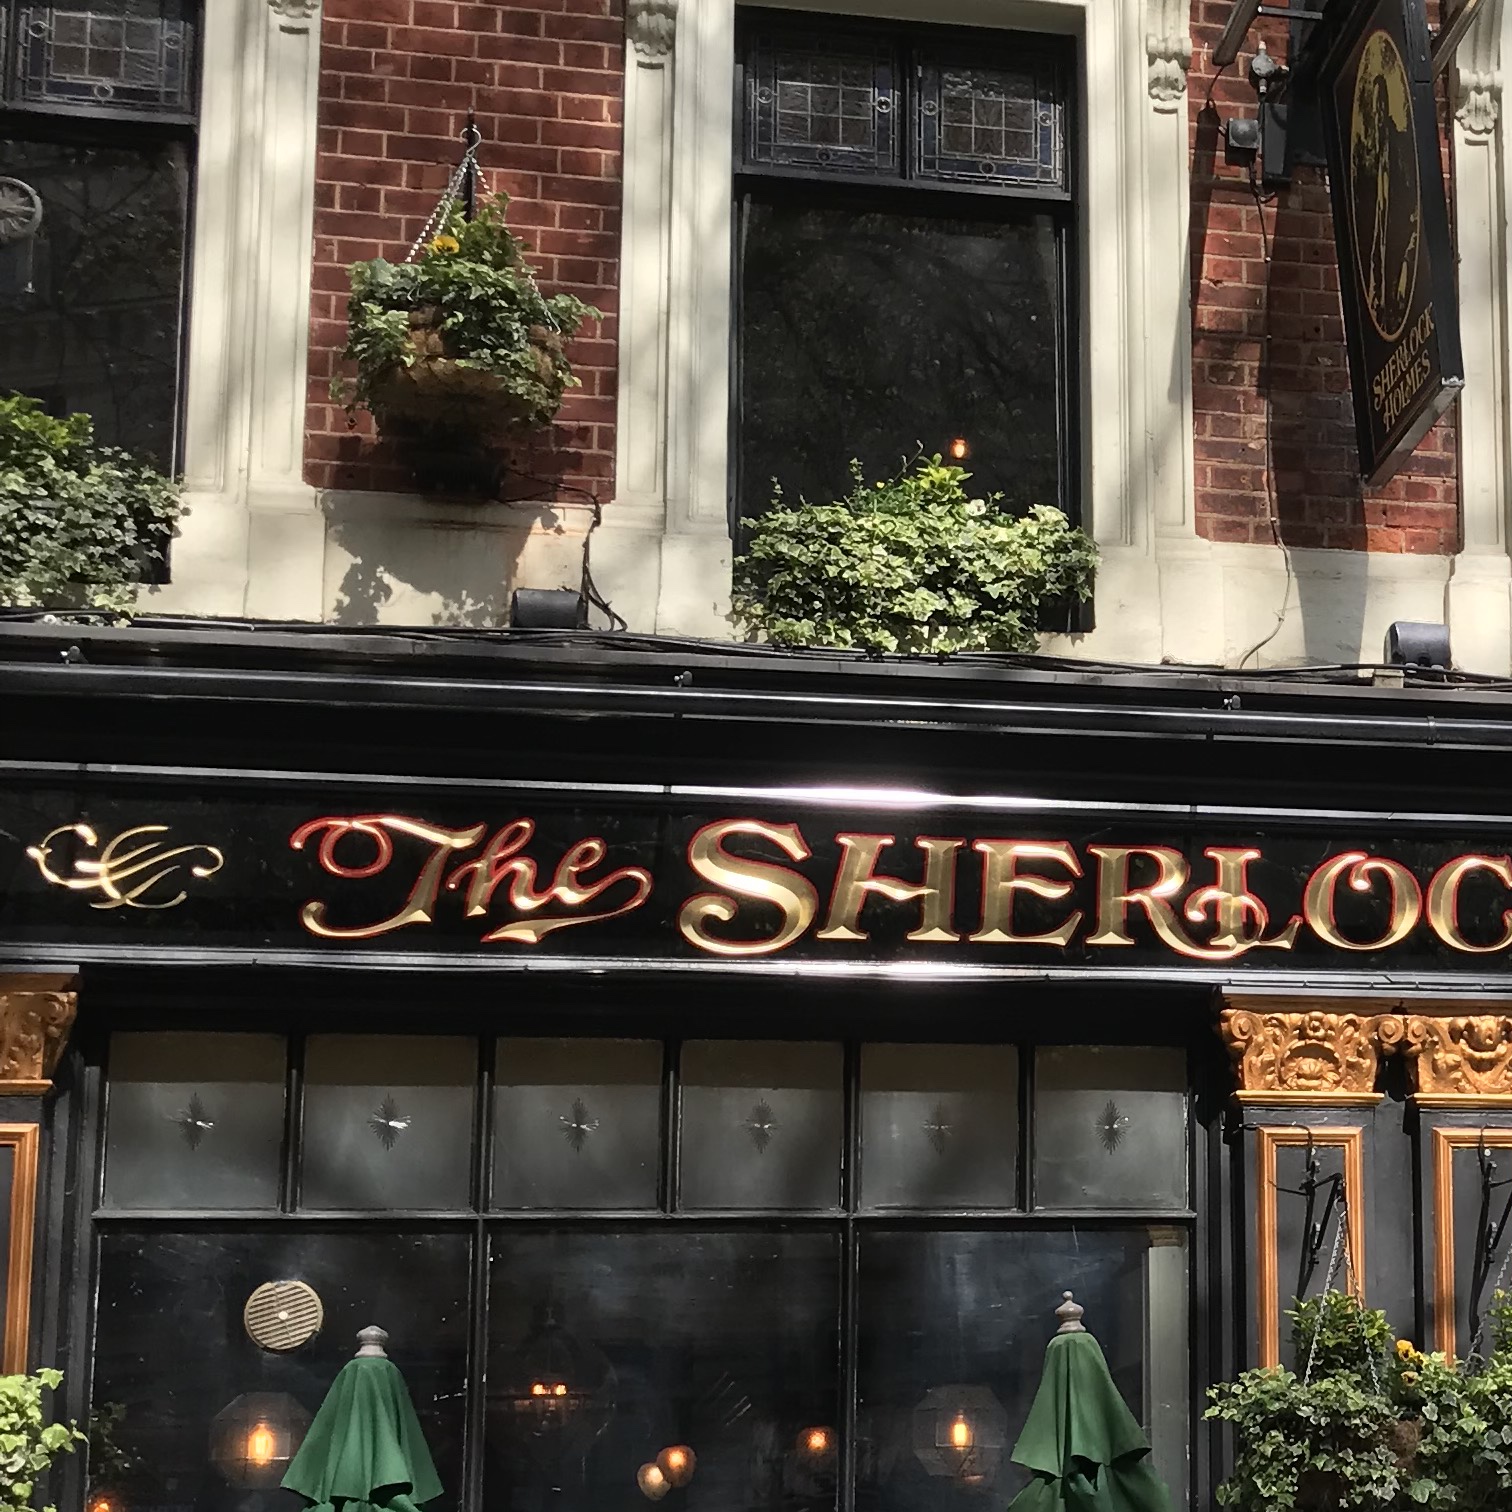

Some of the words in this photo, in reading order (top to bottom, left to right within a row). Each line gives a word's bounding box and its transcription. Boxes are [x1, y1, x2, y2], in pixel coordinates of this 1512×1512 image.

[1372, 301, 1435, 412] SHERLOCK
[1383, 347, 1431, 434] HOLMES
[290, 813, 654, 944] The
